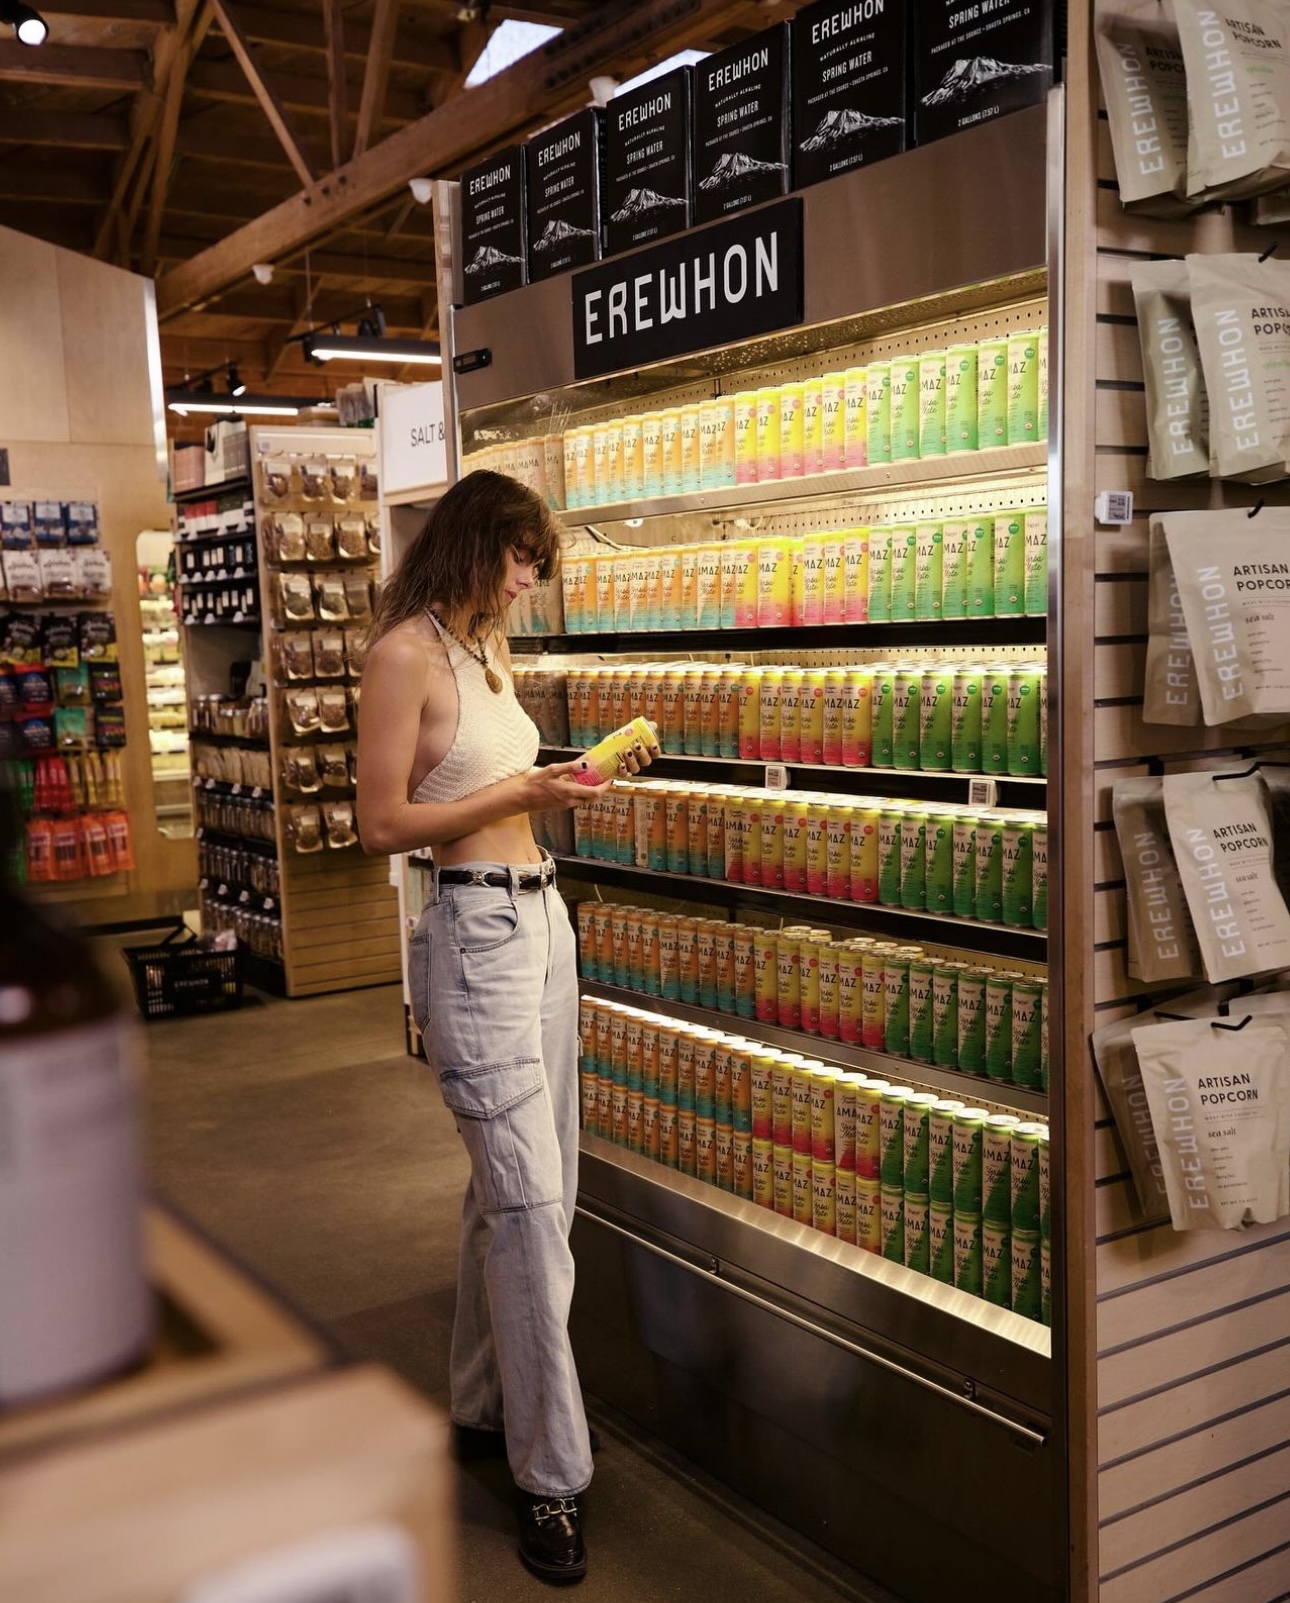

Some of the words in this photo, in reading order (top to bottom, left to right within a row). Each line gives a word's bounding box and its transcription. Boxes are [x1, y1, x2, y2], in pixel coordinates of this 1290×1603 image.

[812, 0, 884, 44] EREWHON
[948, 7, 979, 29] SPRING
[1226, 18, 1266, 38] ARTISAN
[820, 42, 848, 62] NATURALLY
[850, 32, 876, 46] ALKALINE
[1232, 31, 1282, 50] POPCORN
[1145, 46, 1183, 60] ARTIS
[708, 48, 768, 92] EREWHON
[822, 62, 847, 83] SPRING
[848, 50, 872, 71] WATER
[1150, 60, 1185, 73] POPC
[1198, 11, 1247, 160] EREWHON
[715, 91, 739, 108] NATURALLY
[1121, 42, 1164, 176] EREWHON
[618, 92, 672, 131] EREWHON
[717, 109, 738, 128] SPRING
[739, 100, 759, 118] WATER
[538, 132, 580, 167] EREWHON
[626, 148, 646, 165] SPRING
[646, 140, 664, 157] WATER
[470, 164, 511, 195] EREWHON
[545, 182, 560, 198] SPRING
[560, 176, 574, 190] WATER
[476, 210, 490, 225] SPRING
[490, 206, 504, 219] WATER
[585, 231, 778, 346] EREWHON
[1251, 307, 1290, 321] ARTIS
[1254, 323, 1290, 337] POPC
[1157, 317, 1194, 456] EREWHON
[1215, 310, 1260, 452] EREWHON
[411, 424, 435, 447] SALT
[438, 421, 445, 441] &
[1234, 563, 1289, 577] ARTISAN
[1237, 578, 1290, 592] POPCOR
[1245, 615, 1260, 624] sea
[1198, 565, 1243, 702] EREWHON
[1213, 823, 1257, 839] ARTISAN
[1220, 837, 1270, 852] POPCORN
[1134, 830, 1178, 962] EREWHON
[1186, 827, 1245, 960] EREWHON
[1198, 1074, 1250, 1089] ARTISAN
[1200, 1089, 1259, 1106] POPCORN
[836, 1106, 857, 1118] AMA
[1163, 1076, 1210, 1211] EREWHON
[1208, 1130, 1222, 1138] sea
[1222, 1126, 1236, 1137] salt
